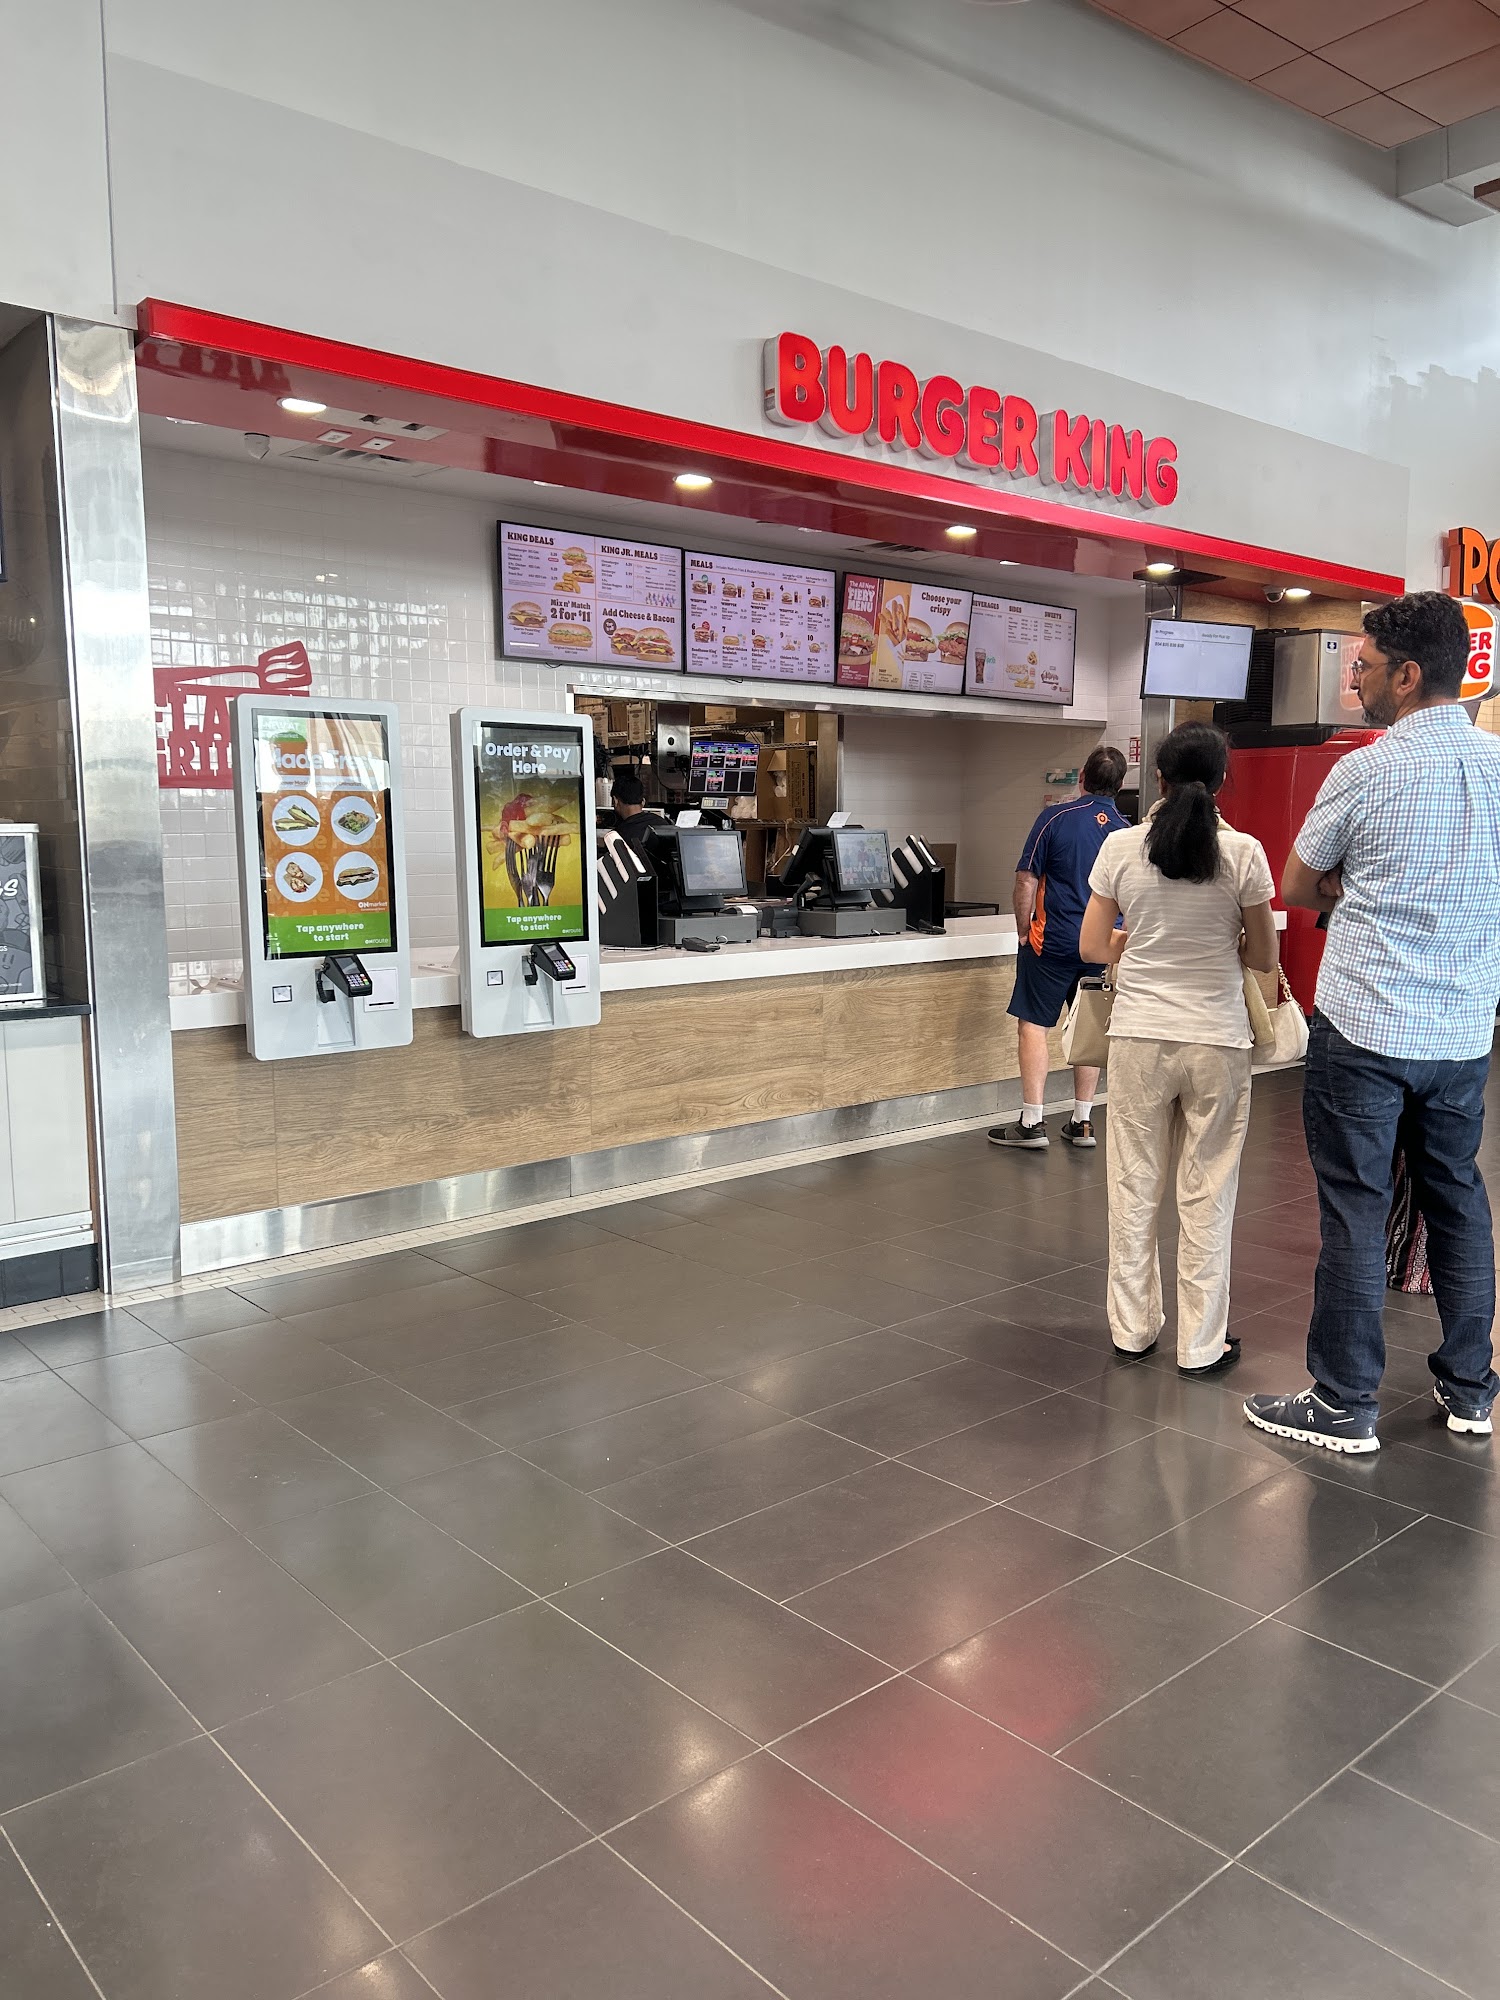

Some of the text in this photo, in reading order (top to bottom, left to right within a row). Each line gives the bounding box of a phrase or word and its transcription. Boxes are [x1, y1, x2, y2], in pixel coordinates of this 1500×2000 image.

[776, 330, 1179, 508] BURGER KING
[508, 532, 554, 546] KING DEALS
[601, 545, 620, 554] KING
[620, 548, 633, 556] JR.
[634, 550, 658, 560] MEALS
[690, 559, 713, 569] MEALS
[848, 586, 876, 602] FIERY
[921, 592, 962, 606] Choose your
[550, 598, 562, 606] Mix
[571, 602, 591, 610] Match
[847, 600, 873, 612] MENU
[930, 605, 951, 616] crispy
[550, 608, 558, 619] 2
[559, 608, 577, 620] for
[602, 608, 618, 617] Add
[618, 610, 646, 620] Cheese
[652, 614, 675, 623] Bacon
[485, 742, 571, 762] Order & Pay
[512, 760, 547, 774] Here
[506, 914, 562, 924] Tap anywhere
[296, 922, 364, 934] Tap anywhere
[325, 933, 349, 941] start
